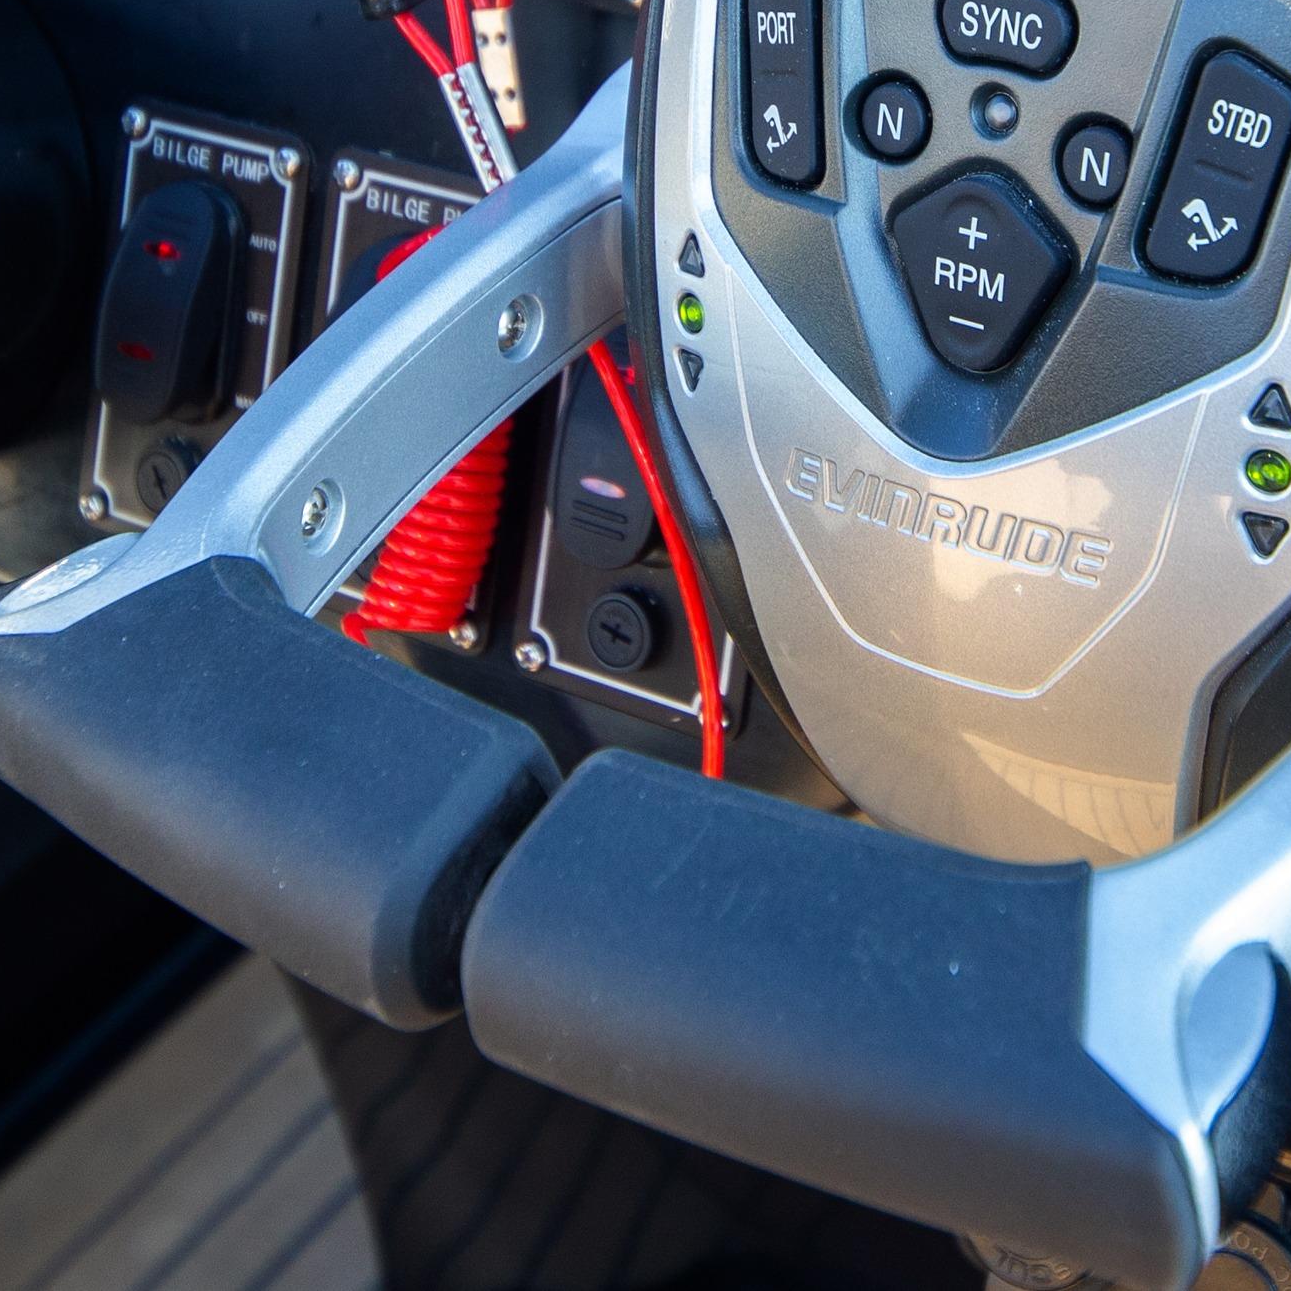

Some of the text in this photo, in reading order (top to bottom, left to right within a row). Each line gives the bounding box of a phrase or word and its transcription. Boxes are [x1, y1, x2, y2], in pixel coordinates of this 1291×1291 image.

[757, 12, 797, 45] PORT
[960, 1, 1043, 50] SYNC
[876, 102, 904, 141] N
[1207, 99, 1272, 149] STBD
[152, 135, 270, 183] BILGE PUMP
[1079, 147, 1110, 186] N
[365, 187, 431, 224] BILGE
[248, 233, 277, 253] AUTO
[934, 256, 1005, 302] RPM
[245, 310, 268, 326] OFF
[785, 447, 1113, 589] EVINRUDE
